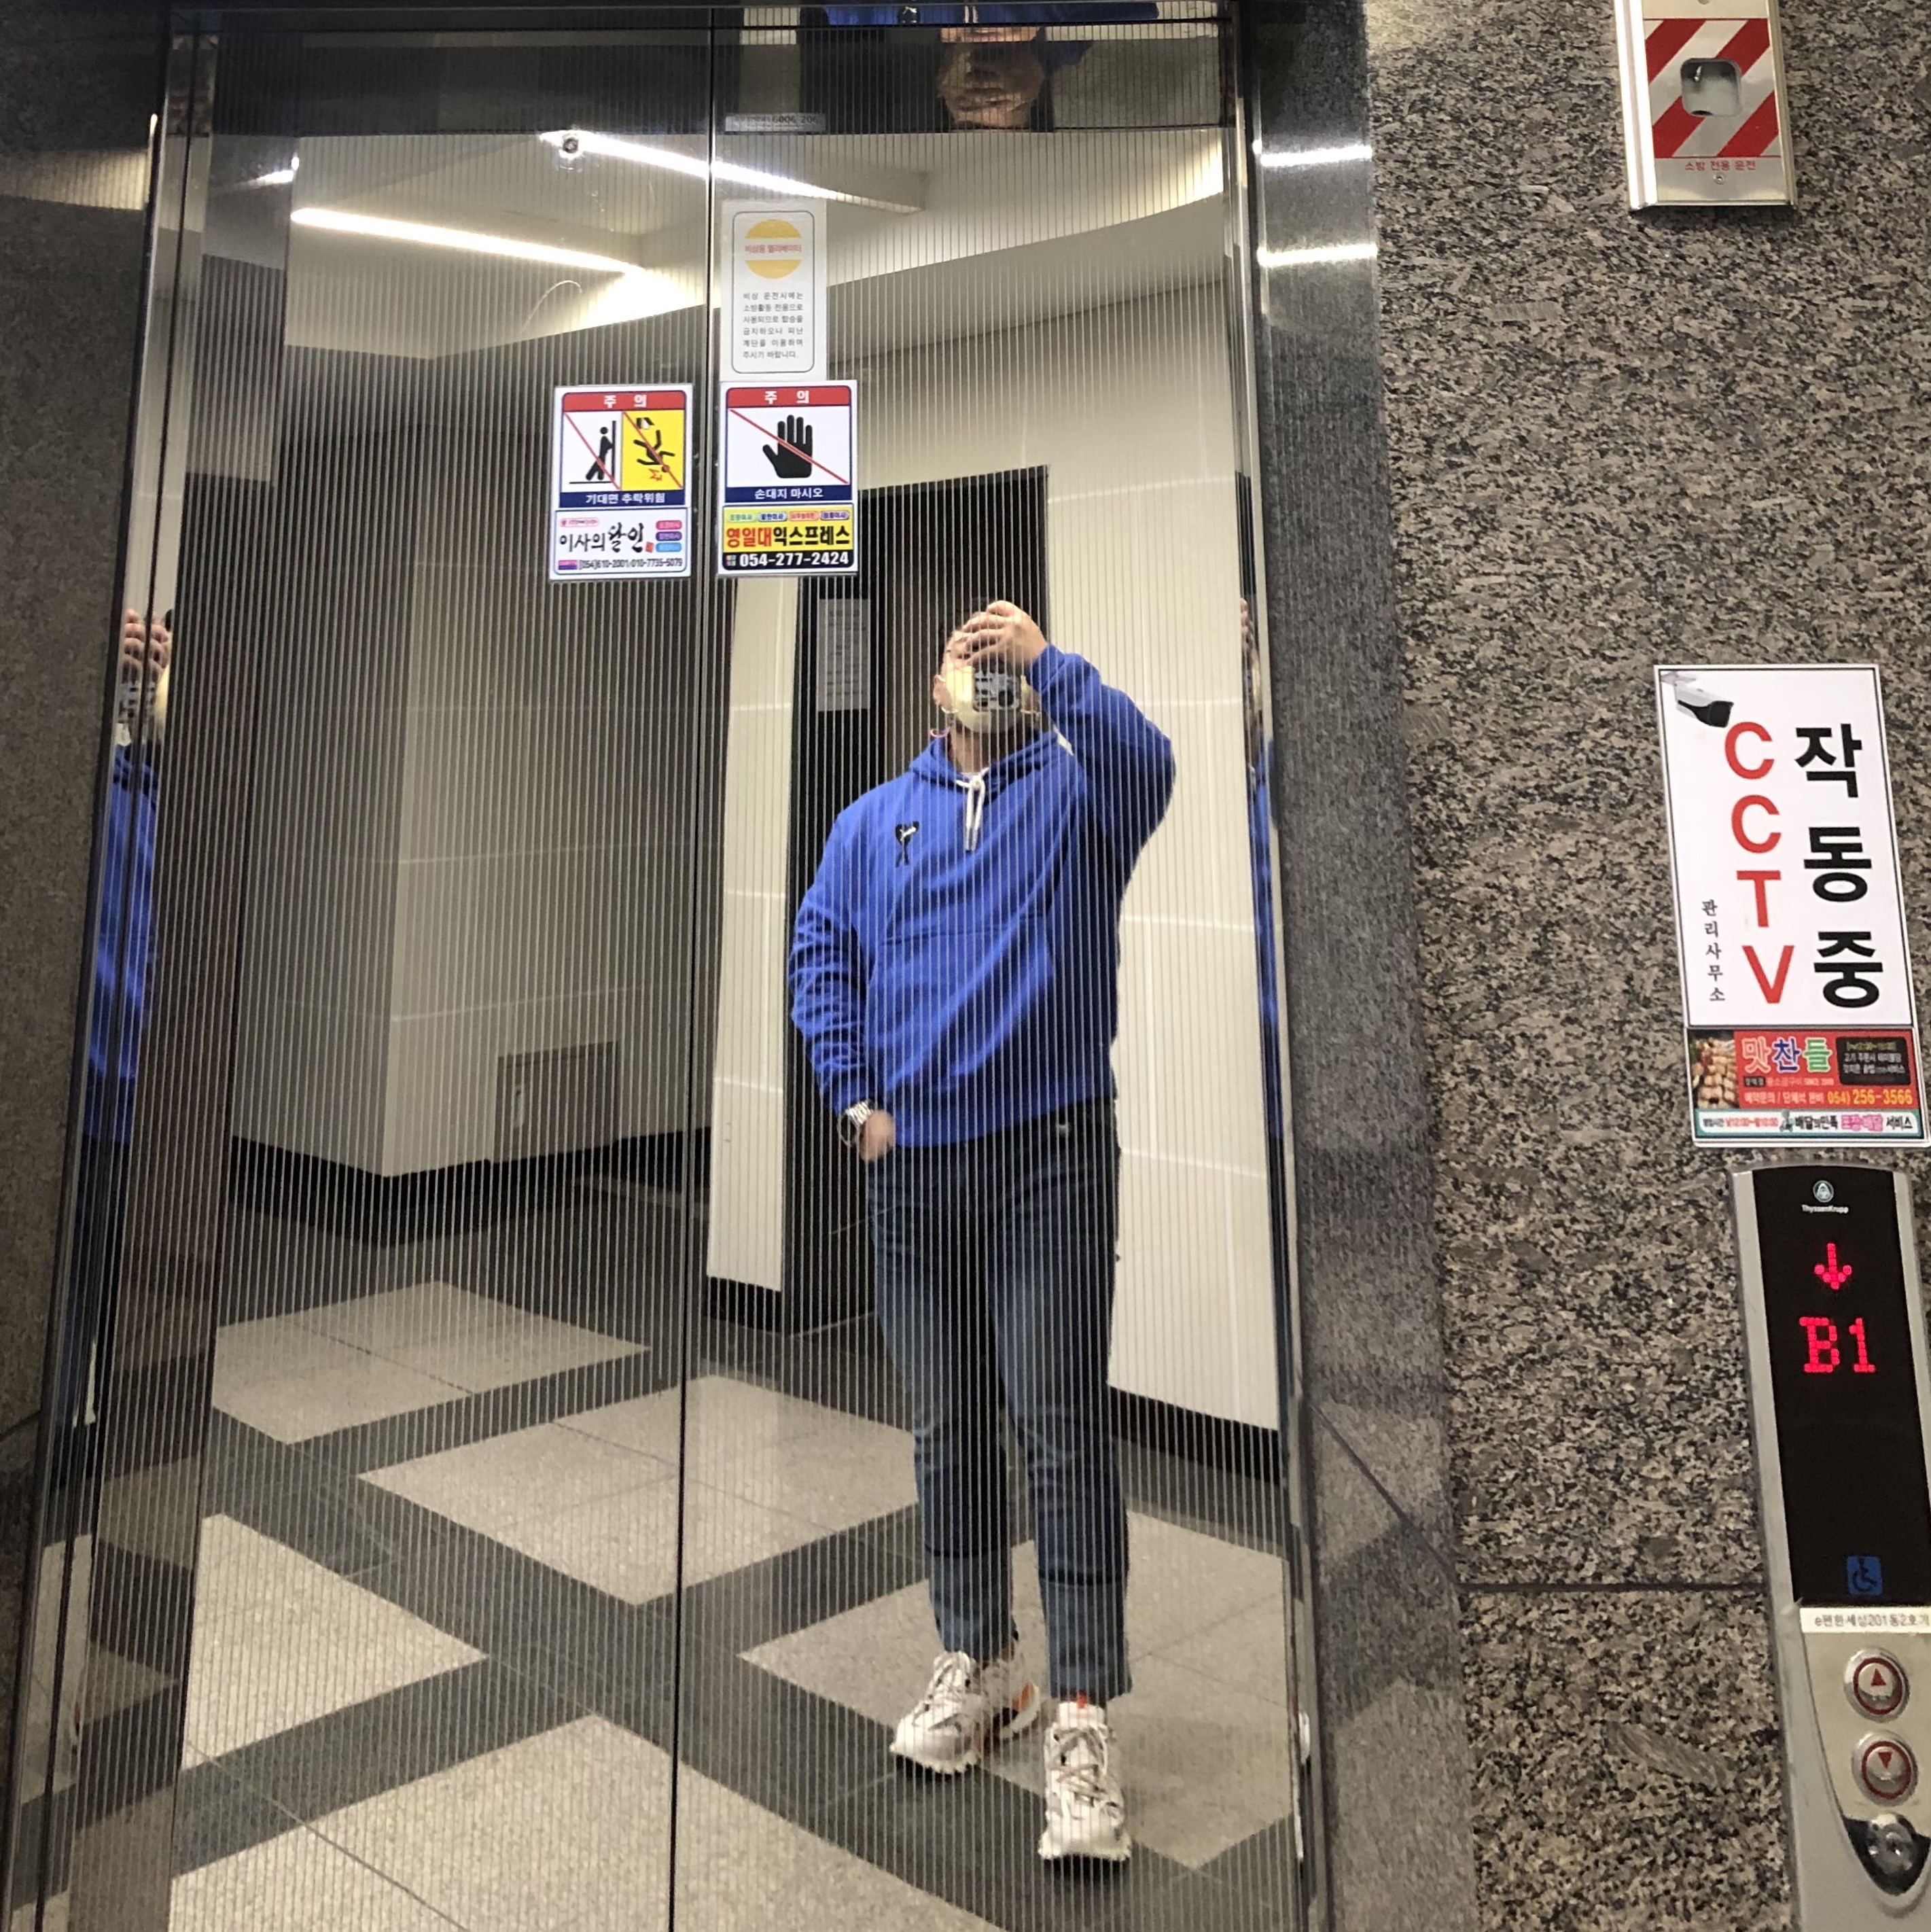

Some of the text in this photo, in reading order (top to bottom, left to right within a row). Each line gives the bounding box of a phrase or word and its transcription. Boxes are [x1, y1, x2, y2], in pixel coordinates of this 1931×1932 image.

[1685, 160, 1756, 171] 소방 전용 운전
[775, 304, 803, 312] 전용으로
[743, 328, 783, 336] 금지하오니
[586, 493, 665, 504] 기대면 추락위험
[755, 488, 823, 499] 손대지 마시오
[739, 551, 849, 567] 054-277-2424
[1701, 899, 1725, 1002] 관리사무소
[1741, 1036, 1833, 1073] 맛찬들
[1852, 1089, 1913, 1105] 256-3566
[1886, 1116, 1913, 1129] 서비스
[1799, 1316, 1877, 1373] B1
